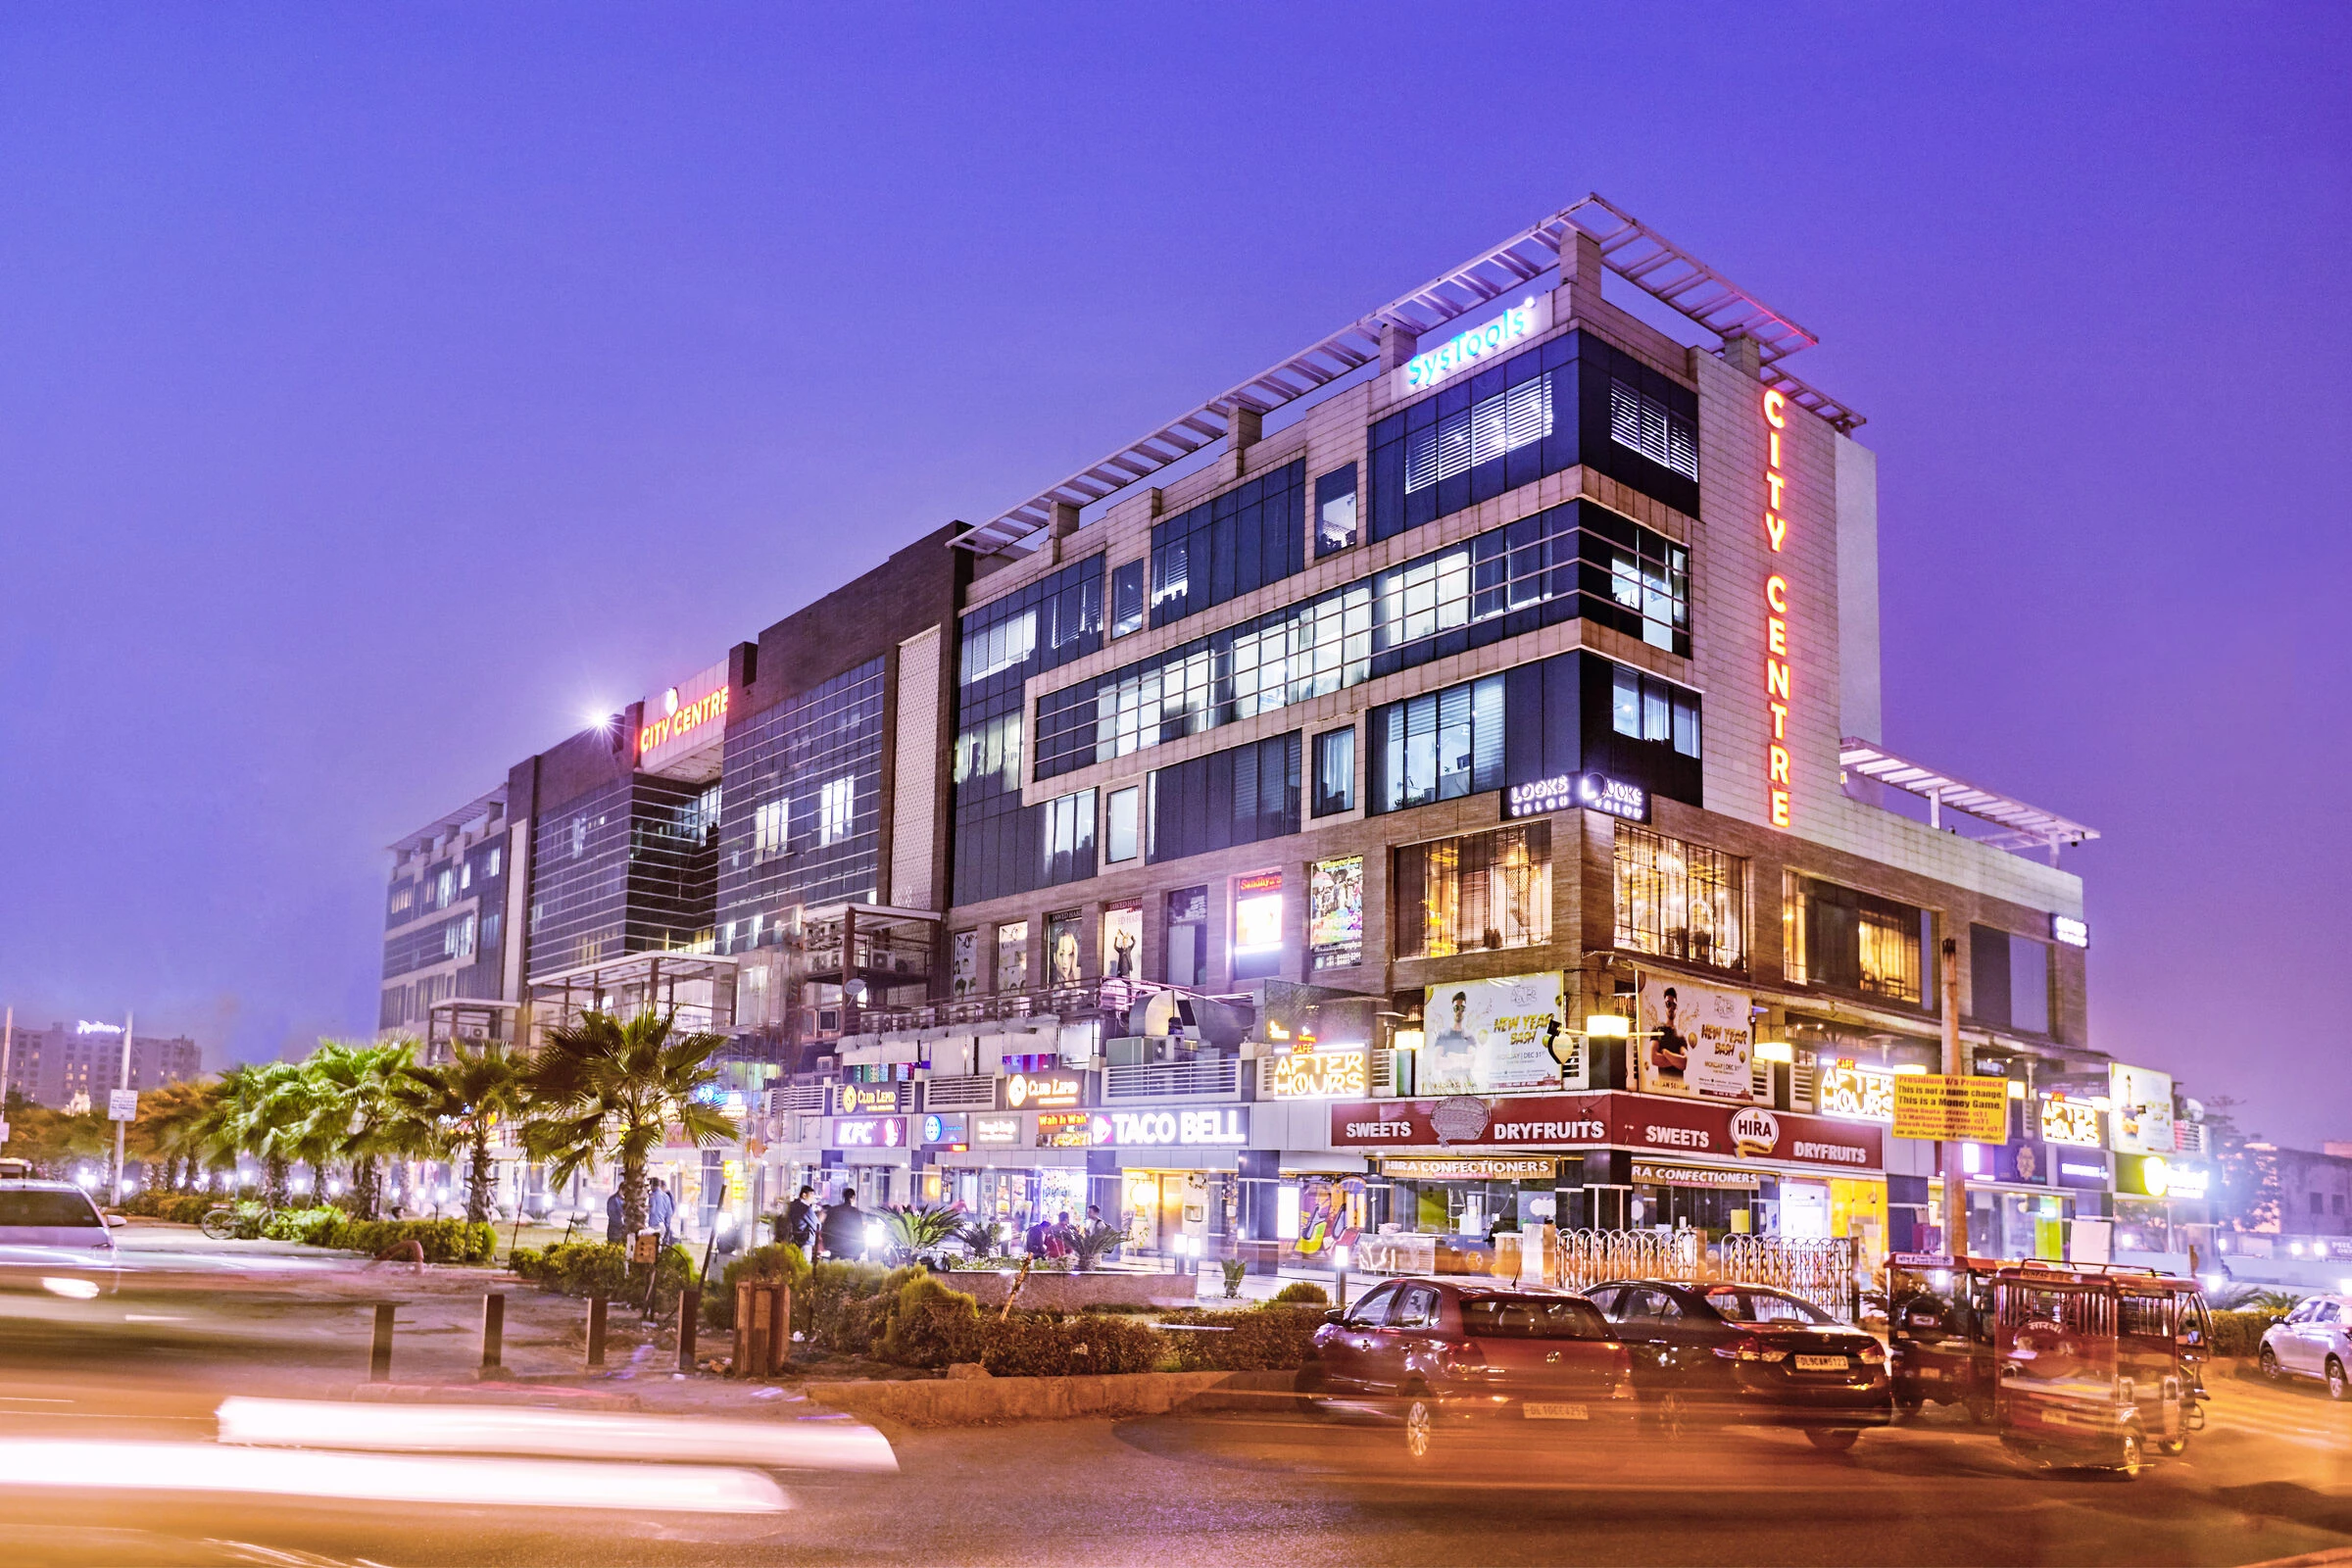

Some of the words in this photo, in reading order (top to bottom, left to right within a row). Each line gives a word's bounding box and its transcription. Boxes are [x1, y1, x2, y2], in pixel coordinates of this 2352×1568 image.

[1408, 309, 1525, 386] SysTools
[1763, 389, 1787, 553] CITY
[1765, 574, 1790, 829] CENTRE
[640, 717, 671, 754] CITY
[673, 685, 729, 737] CENTRE
[1510, 774, 1569, 804] LOOKS
[1494, 1015, 1521, 1032] NEW
[1700, 1024, 1723, 1041] NEW
[1274, 1051, 1365, 1076] AFTER
[1274, 1072, 1365, 1096] HOURS
[1820, 1067, 1893, 1095] AFTER
[1898, 1085, 1914, 1095] This
[1916, 1086, 1923, 1095] is
[1925, 1087, 1938, 1096] not
[1946, 1088, 1969, 1097] name
[1961, 1078, 2004, 1088] Prudence
[858, 1090, 875, 1103] CLUB
[1820, 1088, 1893, 1116] HOURS
[1898, 1096, 1918, 1105] This
[1920, 1097, 1929, 1106] is
[1938, 1098, 1970, 1108] Money
[1039, 1115, 1056, 1126] Wah
[1067, 1113, 1087, 1125] Wah
[1111, 1112, 1177, 1144] TACO
[1180, 1109, 1247, 1144] BELL
[1346, 1120, 1412, 1139] SWEETS
[1494, 1120, 1605, 1140] DRYFRUITS
[1738, 1118, 1773, 1138] HIRA
[838, 1121, 874, 1145] KFC
[1645, 1125, 1710, 1148] SWEETS
[1793, 1141, 1867, 1163] DRYFRUITS
[1385, 1159, 1419, 1172] HIRA
[1421, 1159, 1549, 1174] CONFECTIONERS
[1655, 1167, 1758, 1185] CONFECTIONERS
